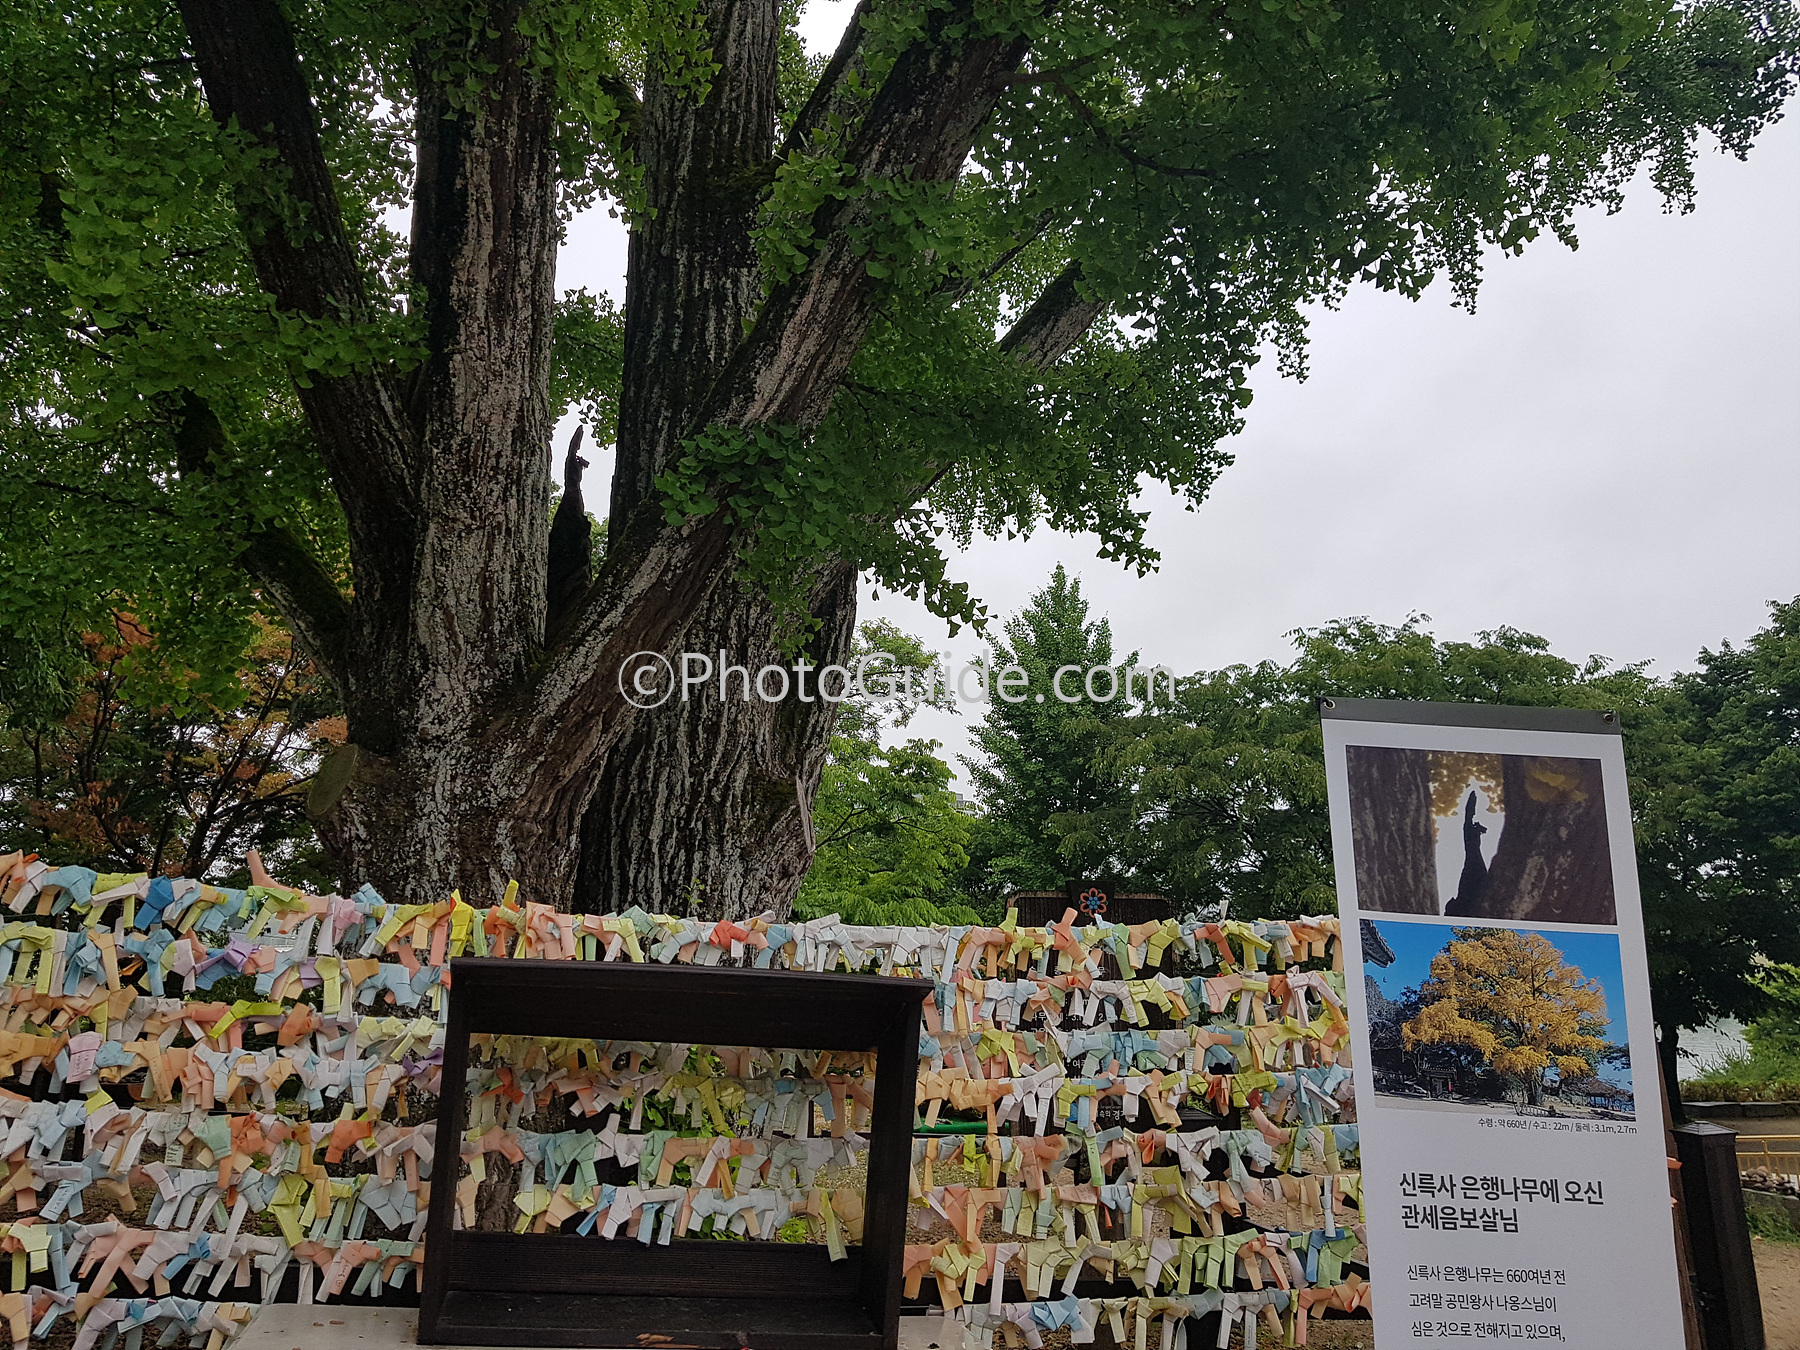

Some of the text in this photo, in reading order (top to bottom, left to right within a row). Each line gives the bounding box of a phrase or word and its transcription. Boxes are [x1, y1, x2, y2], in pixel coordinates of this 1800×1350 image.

[1553, 1122, 1570, 1131] 22m
[1399, 1172, 1604, 1205] 신륵사 은행나무에 오신
[1401, 1204, 1519, 1233] 관세음보살님
[1407, 1264, 1566, 1286] 신륵사 은행나무는 660여년 전
[1409, 1293, 1557, 1312] 고려말 공민왕사 나옹스님이
[1411, 1320, 1566, 1343] 심은 것으로 전해지고 있으며,
